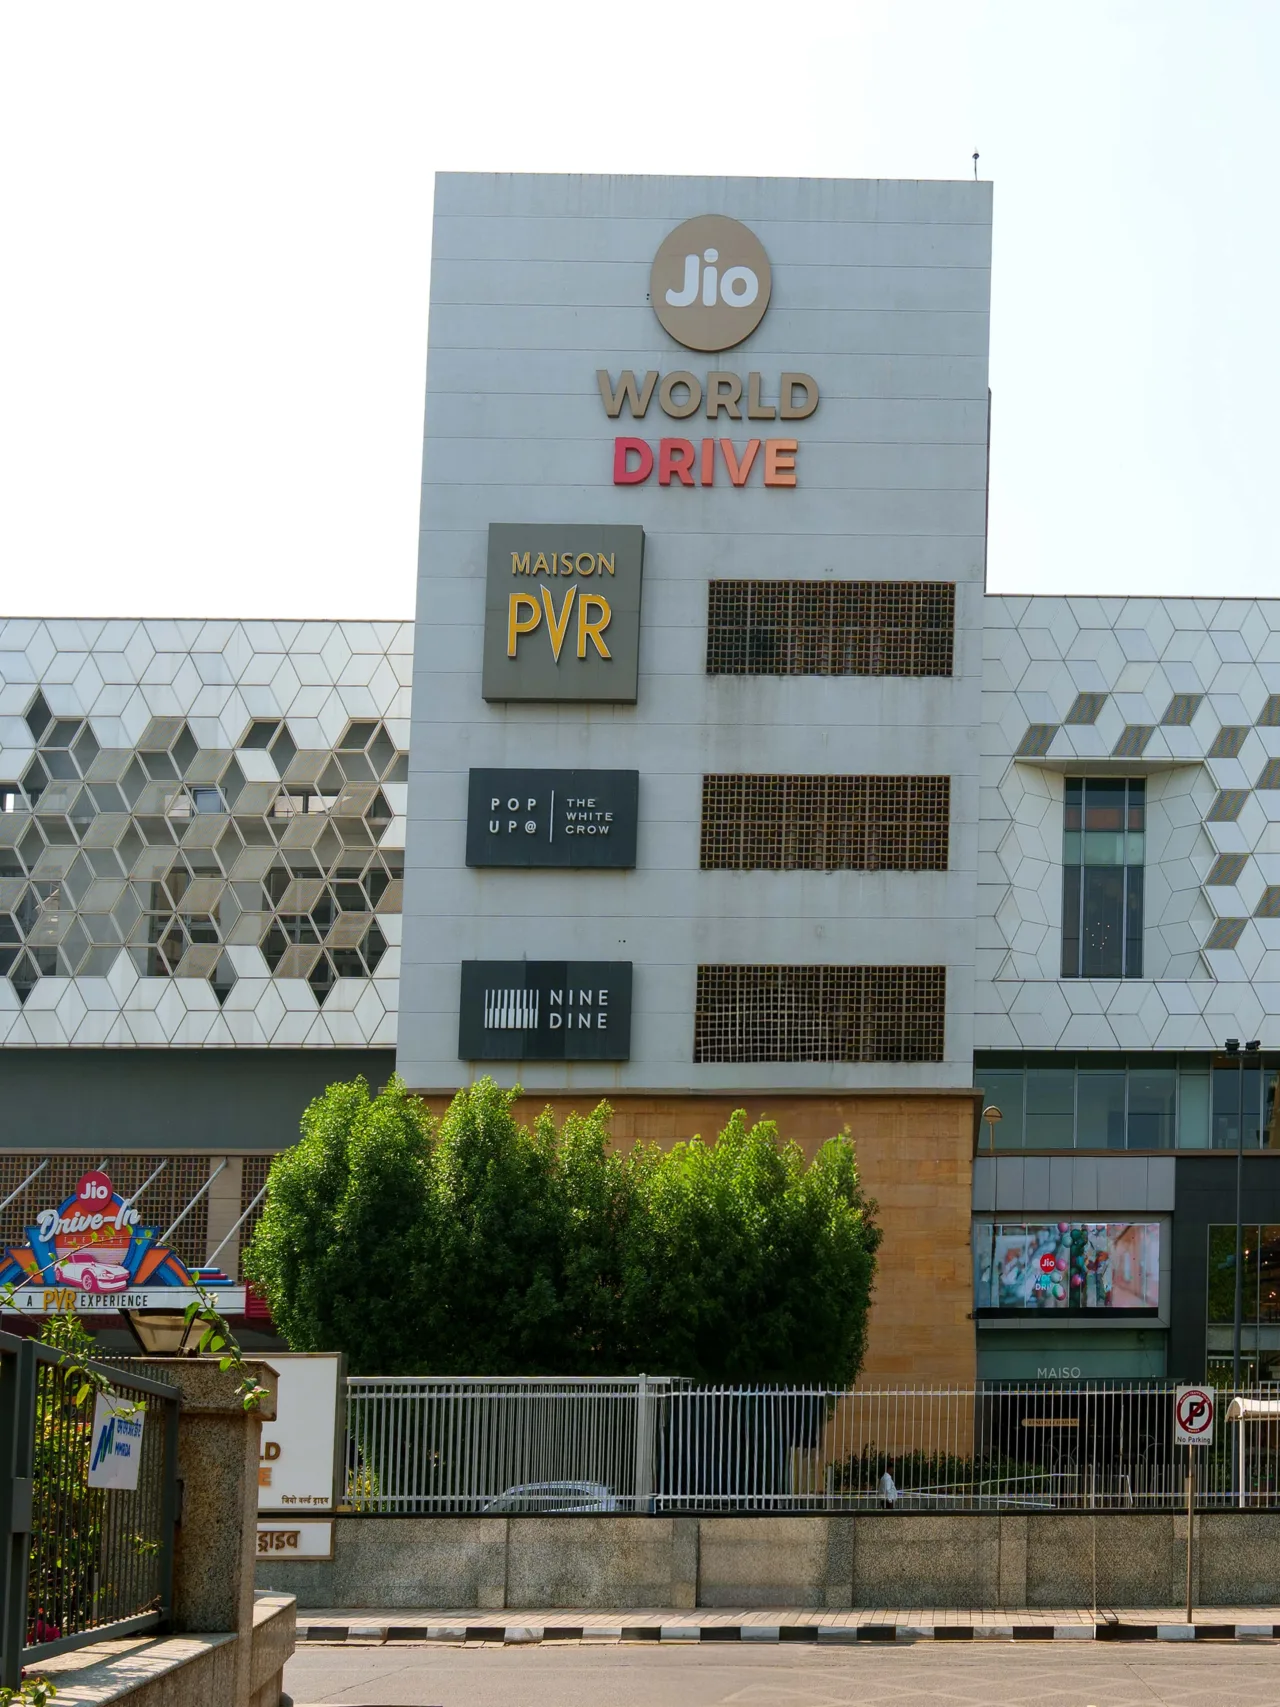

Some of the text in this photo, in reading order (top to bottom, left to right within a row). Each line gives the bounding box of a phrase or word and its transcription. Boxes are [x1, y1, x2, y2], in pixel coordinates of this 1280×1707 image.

[665, 248, 759, 308] Jio
[595, 369, 820, 421] WORLD
[613, 436, 798, 487] DRIVE
[510, 551, 616, 577] MAISON
[507, 583, 612, 664] PVR
[490, 797, 537, 812] POP
[566, 798, 597, 808] THE
[566, 811, 614, 822] WHITE
[565, 825, 610, 835] CROW
[549, 989, 609, 1006] NINE
[549, 1012, 608, 1029] DINE
[80, 1181, 109, 1200] Jio
[36, 1198, 141, 1243] Drive-In
[1041, 1258, 1055, 1267] Jio
[26, 1287, 149, 1313] A PVR EXPERIENCE
[1187, 1436, 1211, 1445] Parking
